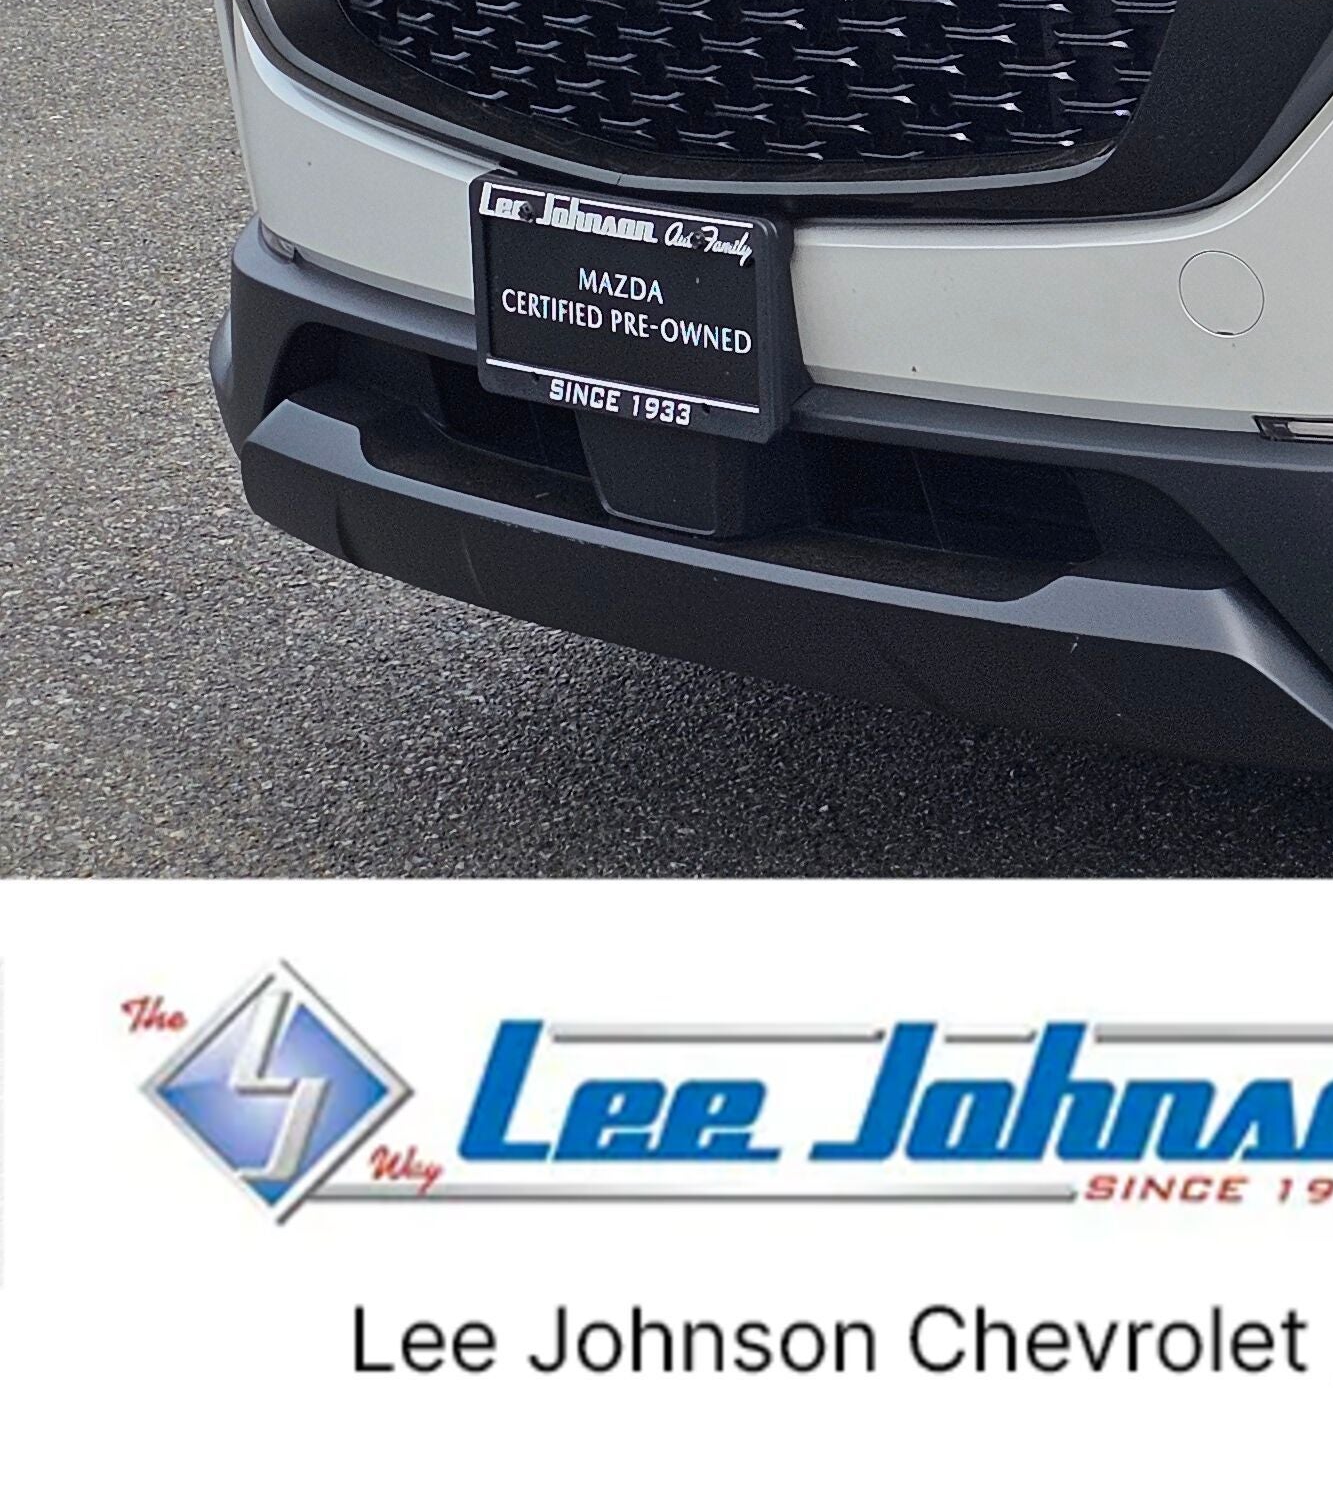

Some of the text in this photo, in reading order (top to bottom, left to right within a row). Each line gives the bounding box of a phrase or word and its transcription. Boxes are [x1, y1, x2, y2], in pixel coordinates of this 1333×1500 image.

[535, 193, 658, 243] Johnson
[578, 267, 664, 305] MAZDA
[501, 288, 752, 354] CERTIFIED PRE-OWNED
[549, 378, 692, 426] SINCE 1933
